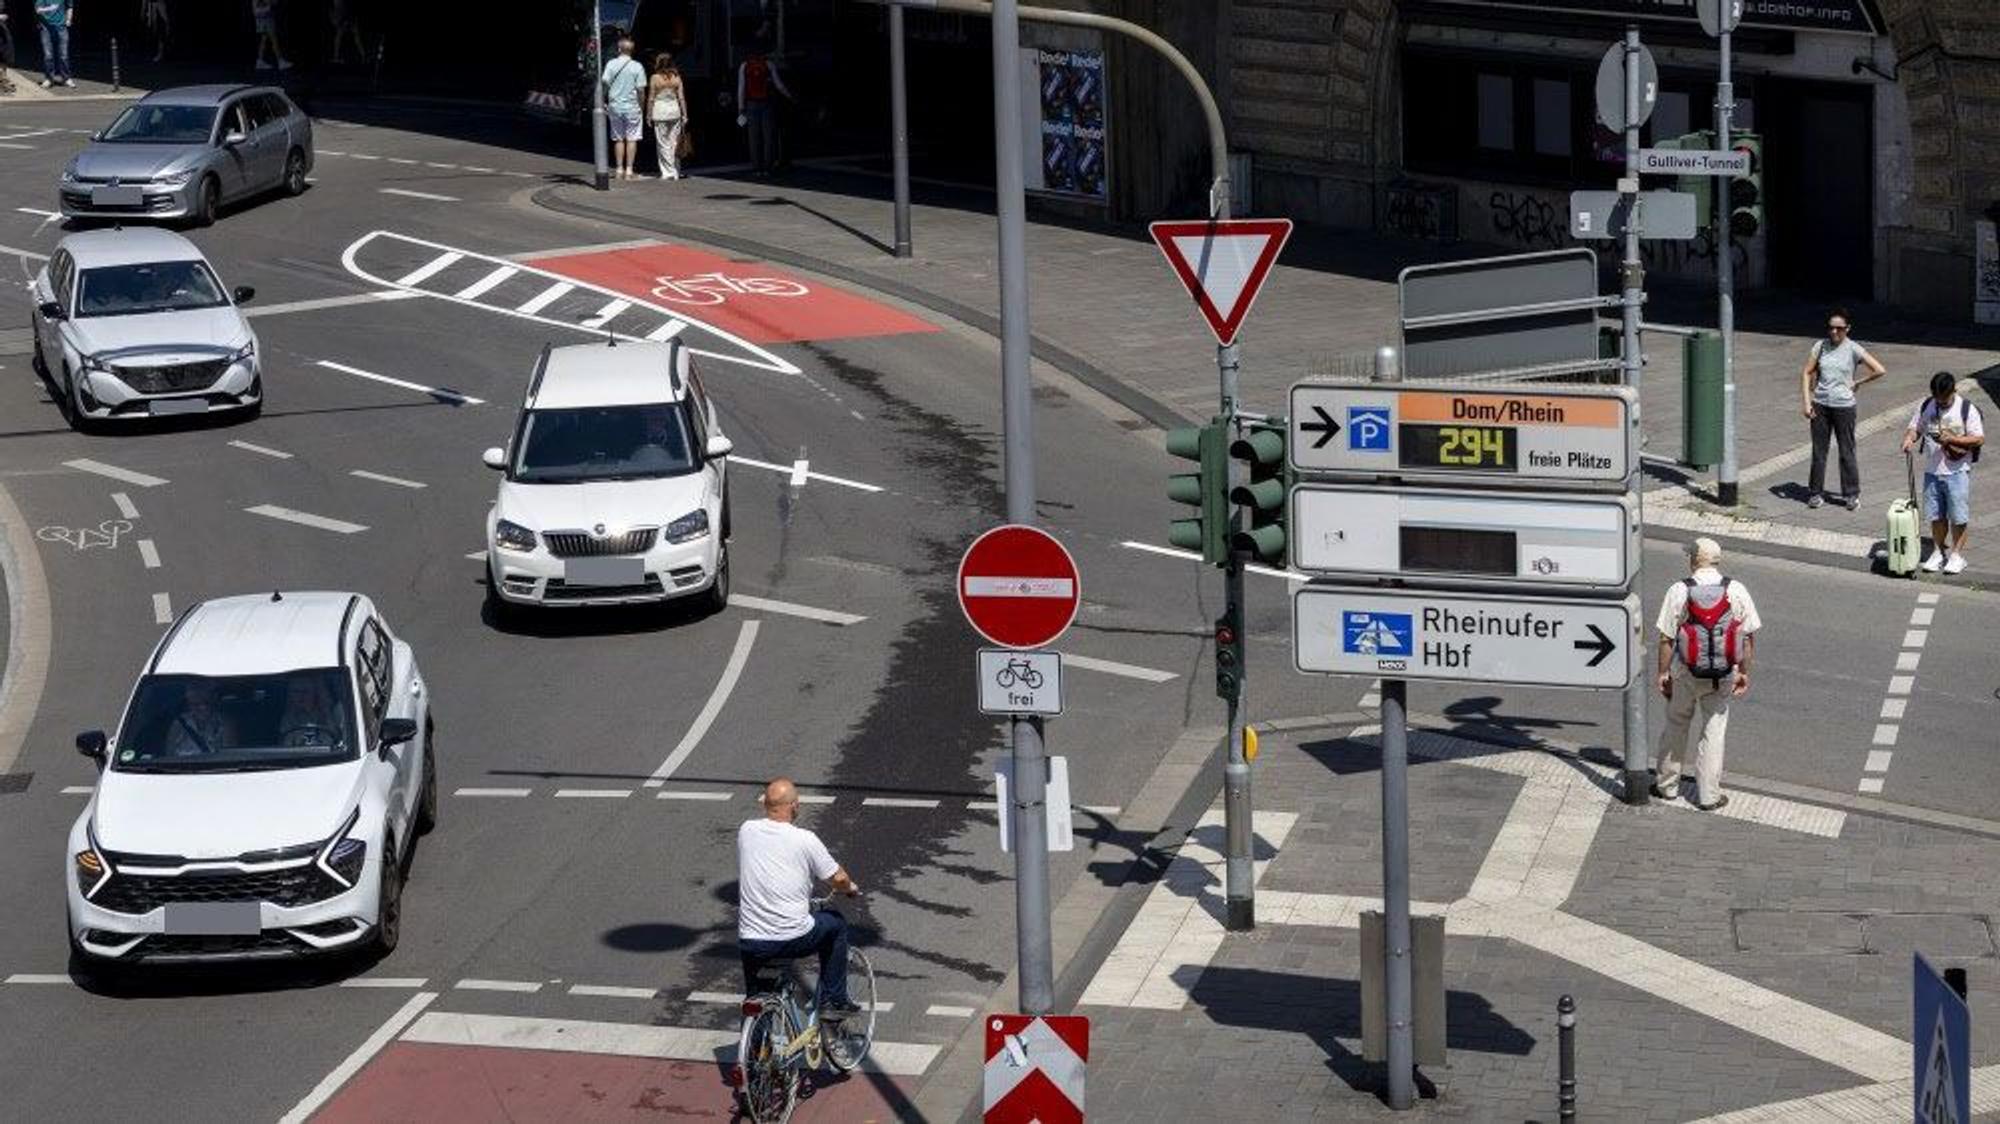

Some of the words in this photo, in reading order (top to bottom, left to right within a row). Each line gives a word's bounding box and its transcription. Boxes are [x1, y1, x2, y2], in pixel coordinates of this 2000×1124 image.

[1647, 155, 1744, 170] Gulliver-Tunnel
[1452, 398, 1565, 423] Dom/Rhein
[1439, 427, 1504, 465] 294
[1529, 450, 1562, 468] freie
[1567, 451, 1612, 470] Plätze
[1423, 608, 1563, 638] Rheinufer
[1423, 643, 1473, 669] Hbf
[1008, 691, 1034, 706] frei
